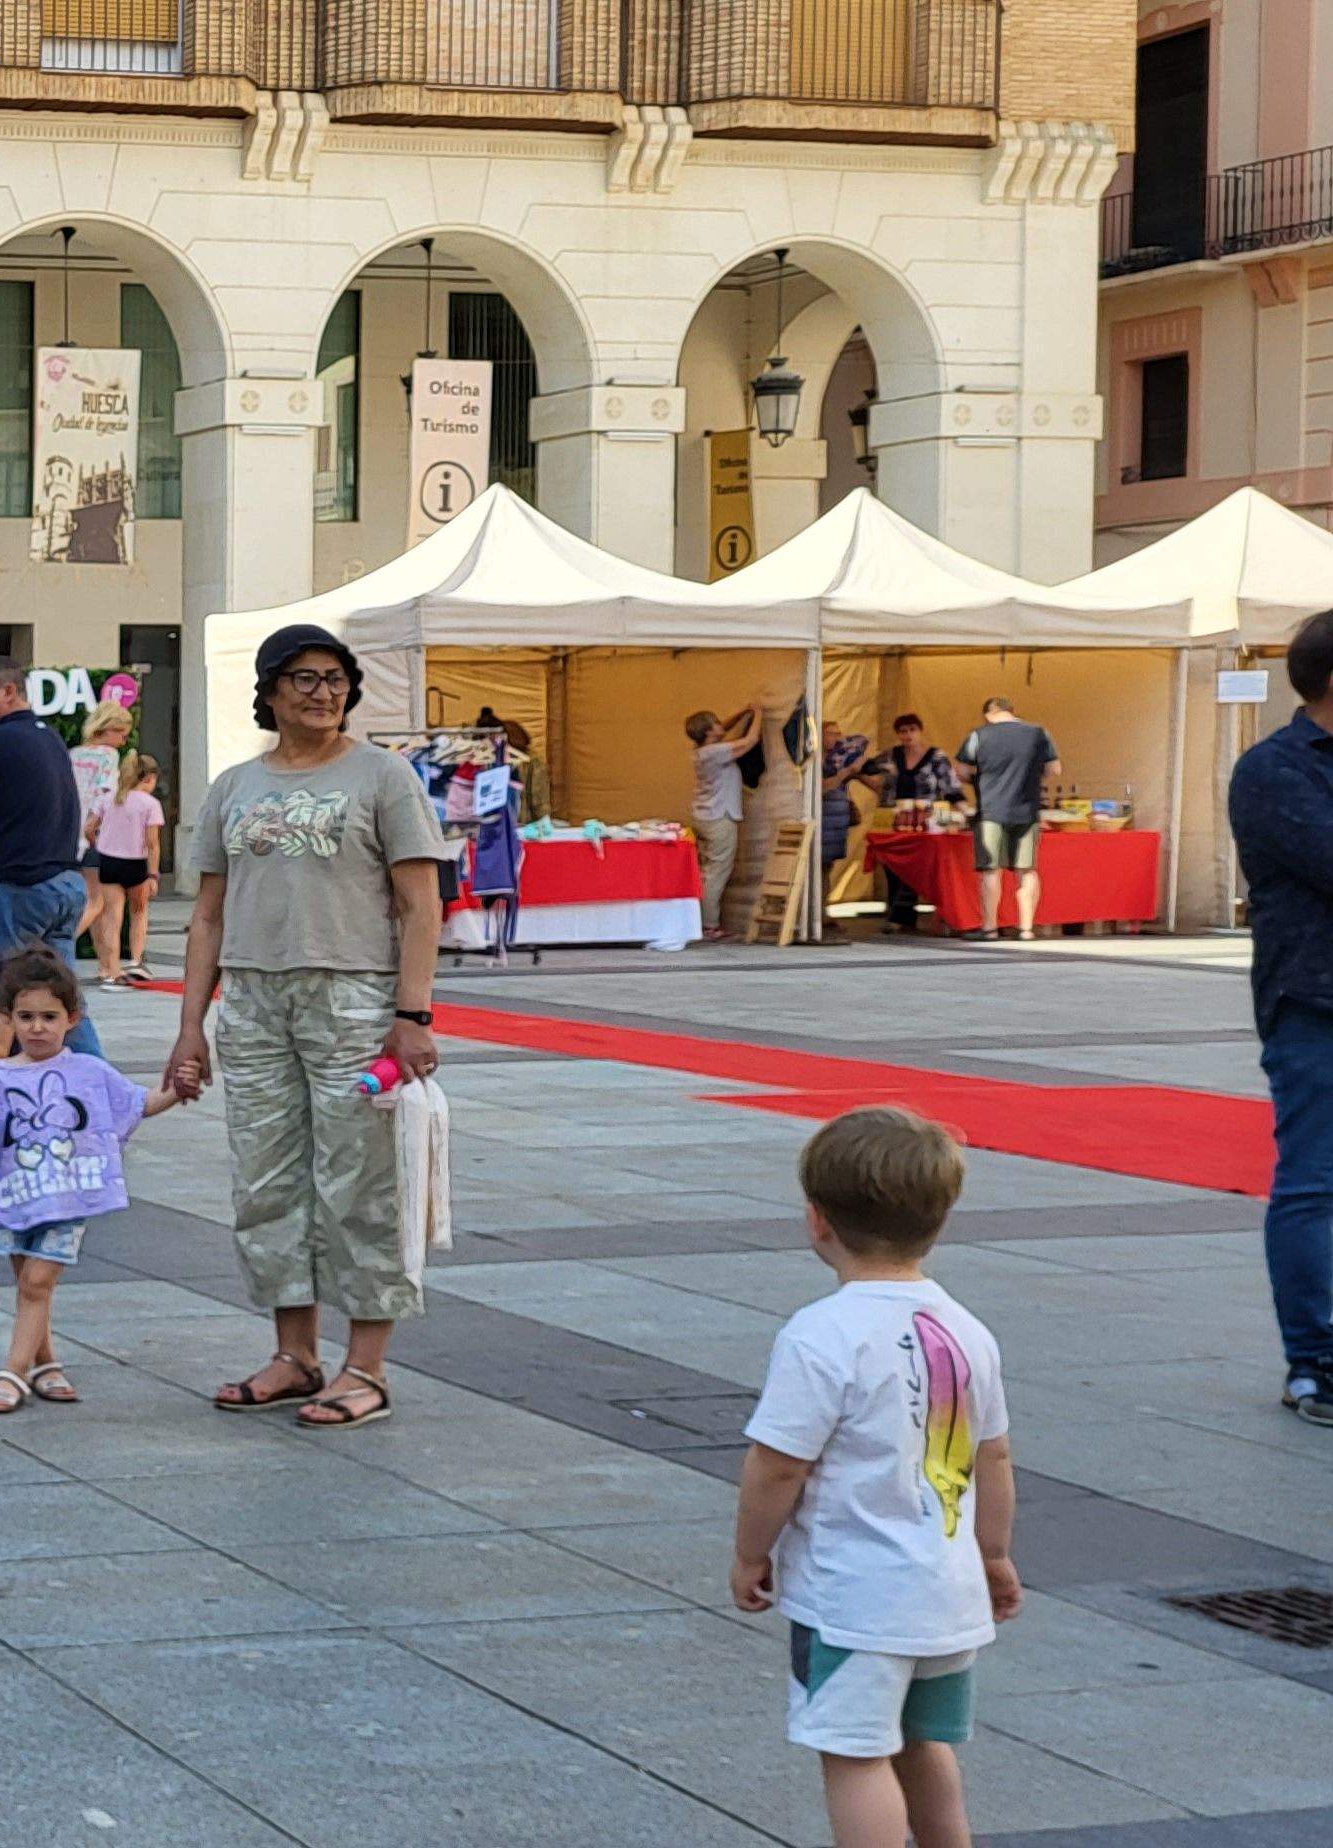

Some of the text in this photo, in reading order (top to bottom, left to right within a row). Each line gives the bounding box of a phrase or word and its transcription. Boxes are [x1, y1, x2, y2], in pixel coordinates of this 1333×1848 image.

[429, 381, 480, 397] Oficina
[81, 391, 130, 415] HUESCA
[461, 401, 480, 416] de
[421, 418, 479, 434] Turismo
